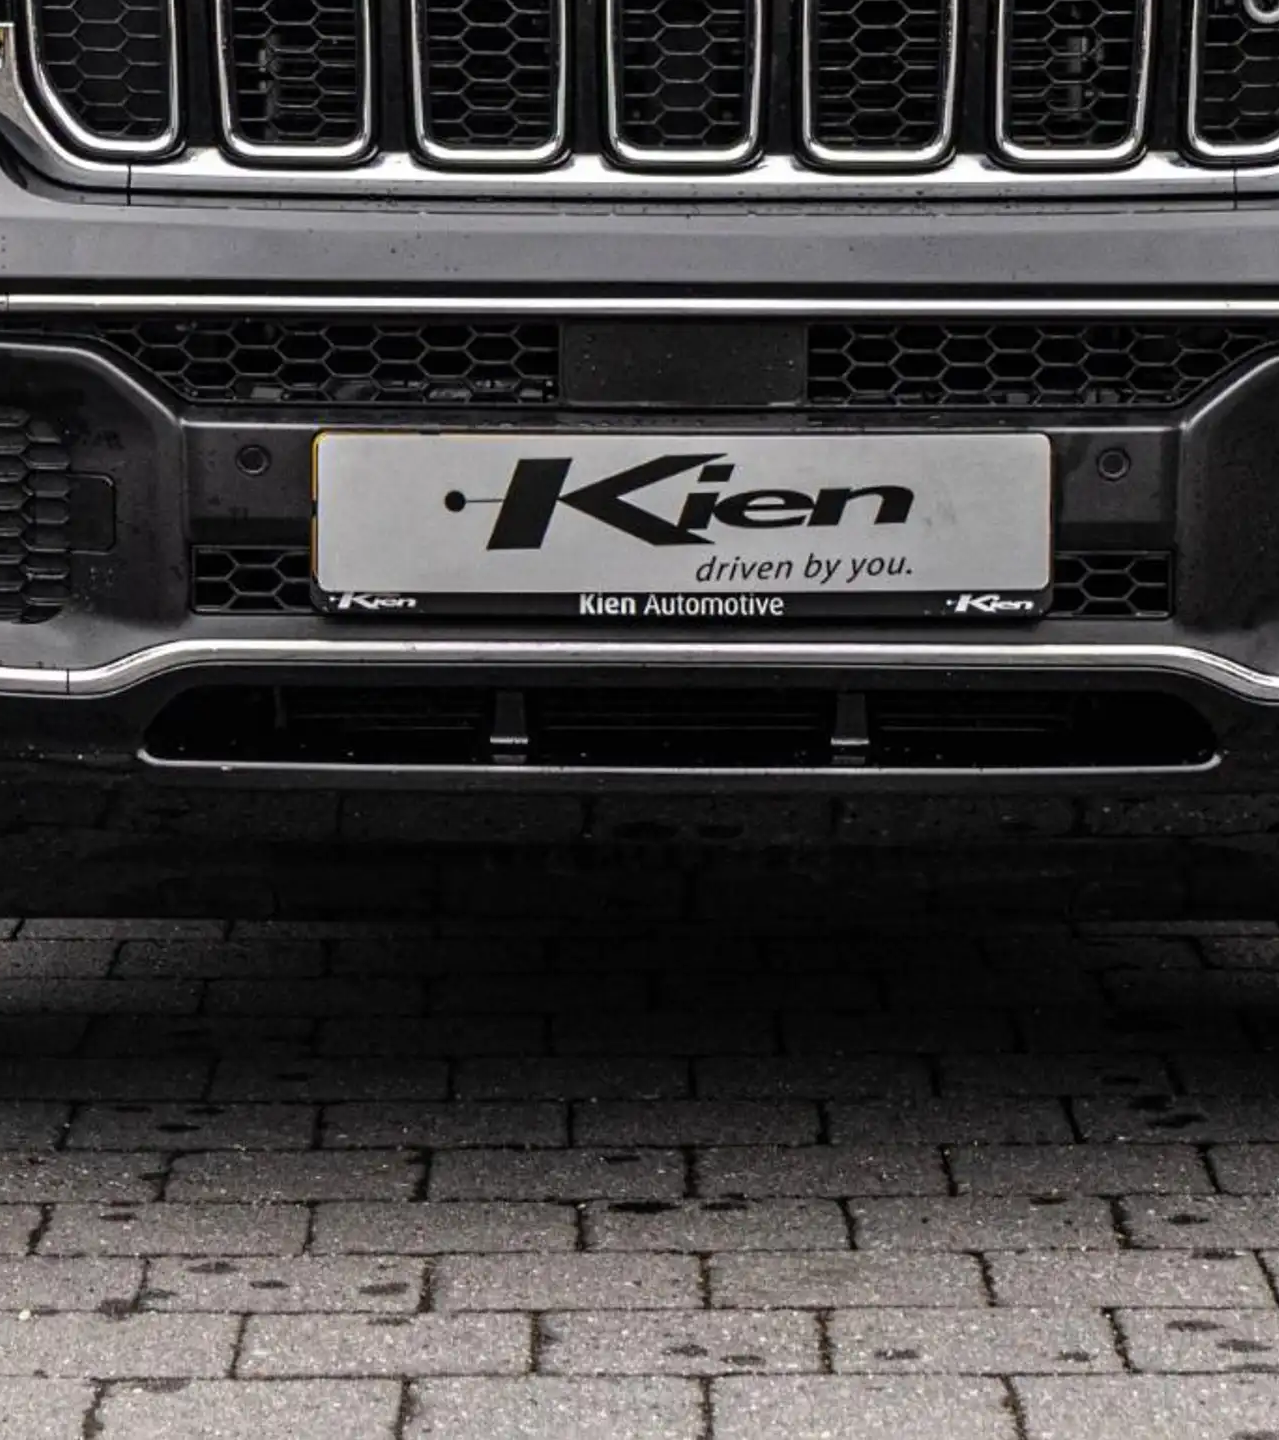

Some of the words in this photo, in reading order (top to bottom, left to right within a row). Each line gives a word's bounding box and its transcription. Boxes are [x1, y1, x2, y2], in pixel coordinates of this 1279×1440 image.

[486, 453, 915, 550] Kien
[695, 555, 793, 582] driven
[803, 553, 841, 584] by
[845, 555, 913, 583] you.
[579, 592, 636, 616] Kien
[643, 592, 785, 616] Automotive
